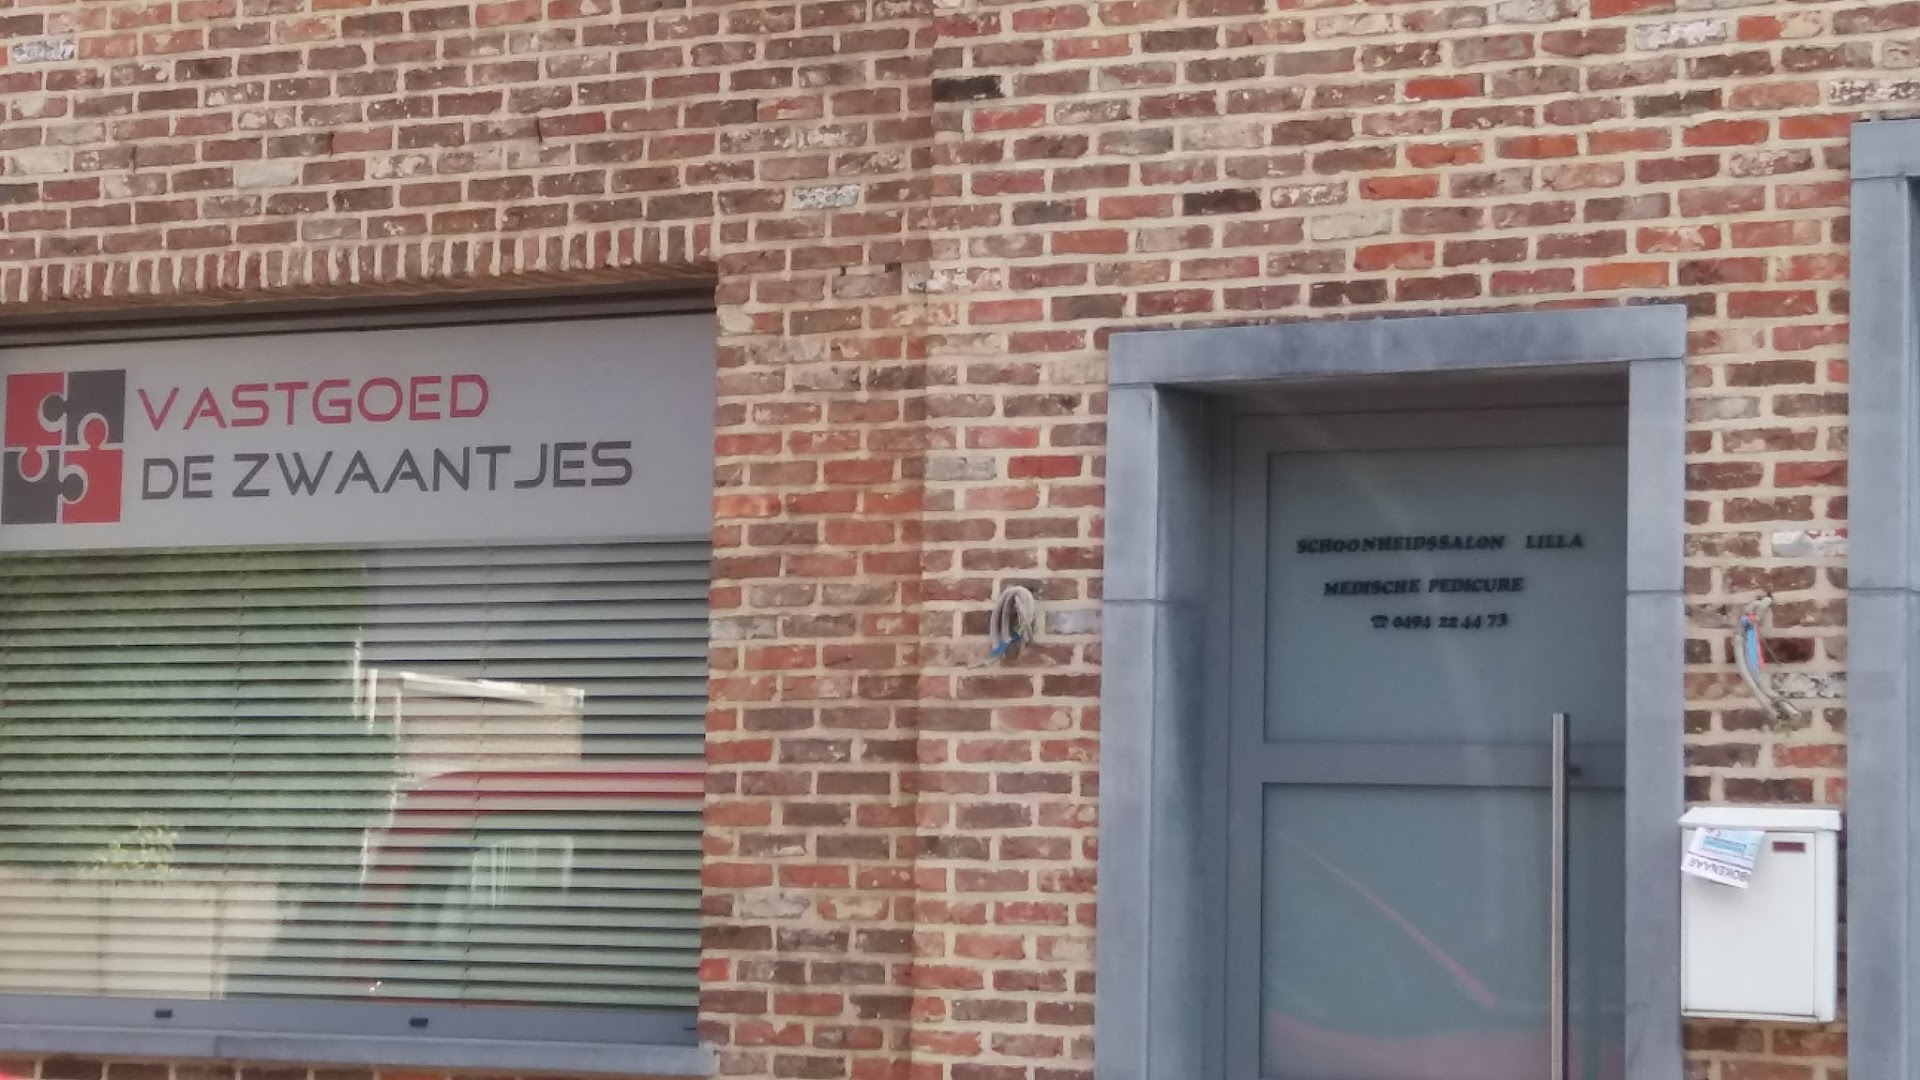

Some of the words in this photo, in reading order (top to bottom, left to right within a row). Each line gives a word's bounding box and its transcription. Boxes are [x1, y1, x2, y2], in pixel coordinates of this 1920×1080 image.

[138, 374, 489, 431] VASTGOED
[142, 455, 214, 501] DE
[233, 440, 634, 499] ZWAANTJES
[1296, 535, 1505, 554] SCHOONHEIDSSALON
[1525, 533, 1585, 549] LILLA
[1323, 578, 1421, 596] MEDISCHE
[1428, 576, 1525, 593] PEDICURE
[1392, 614, 1432, 630] 0494
[1438, 615, 1459, 629] 22
[1460, 614, 1482, 630] 44
[1487, 612, 1509, 628] 73
